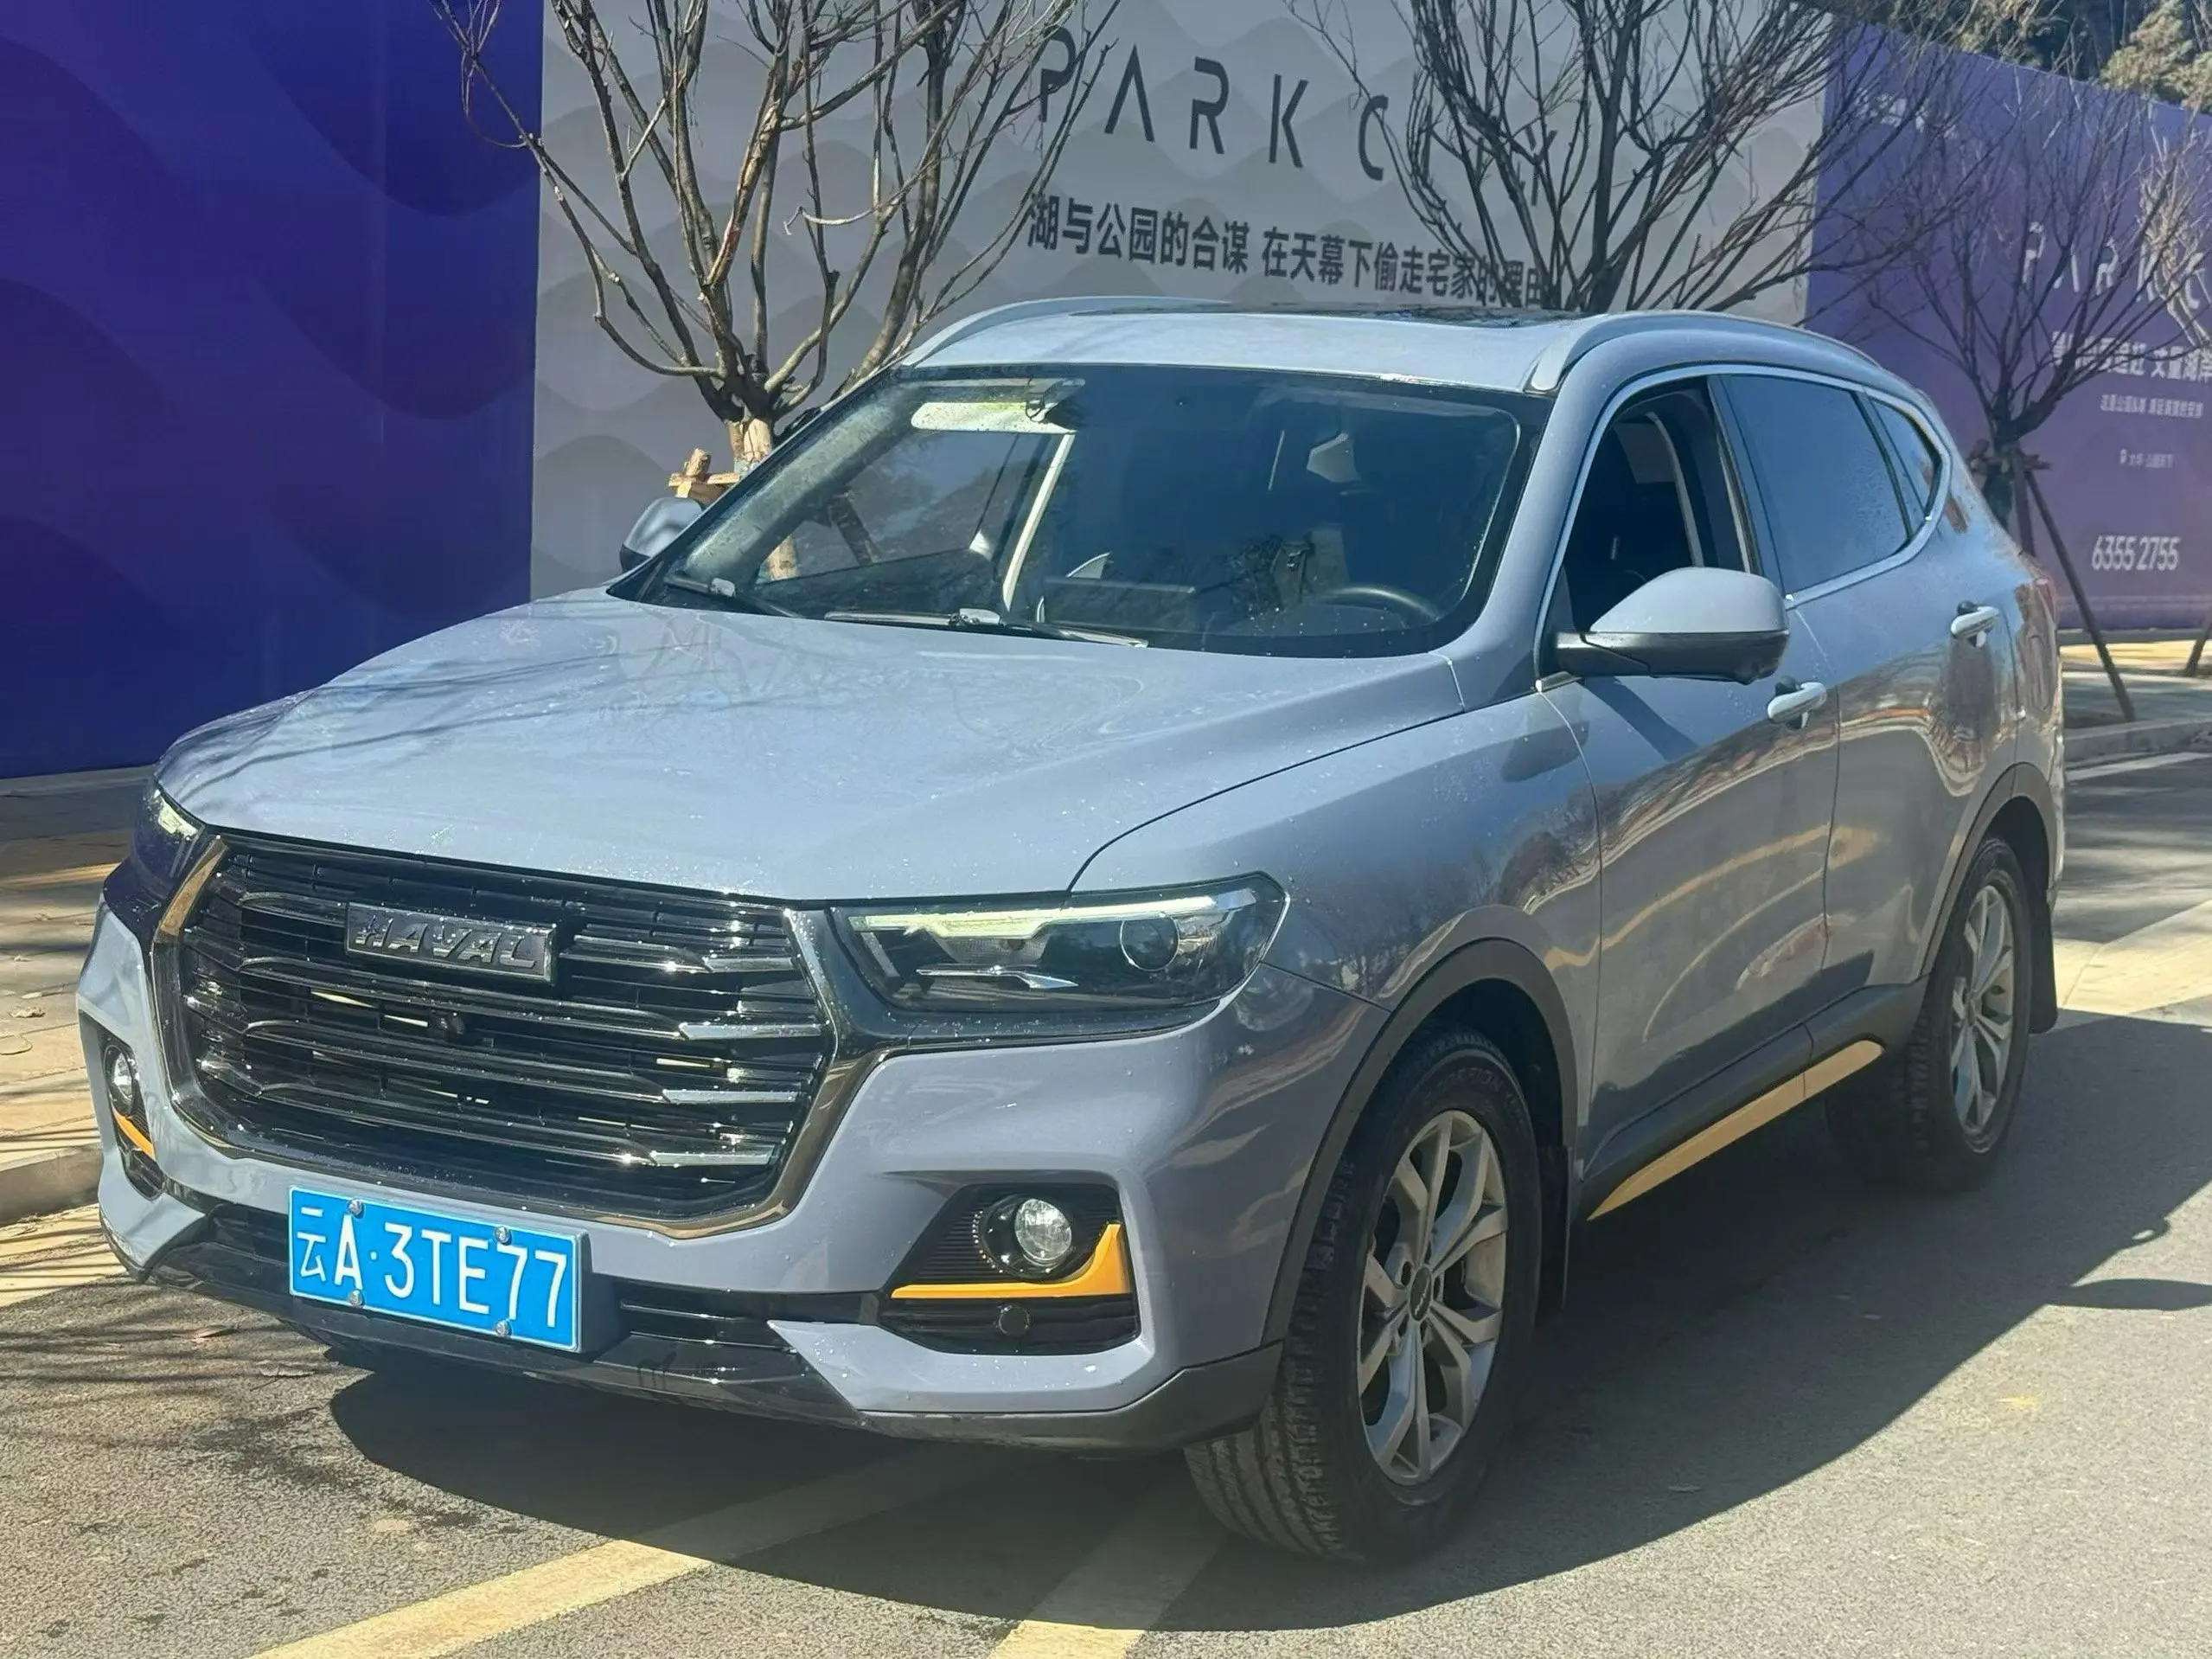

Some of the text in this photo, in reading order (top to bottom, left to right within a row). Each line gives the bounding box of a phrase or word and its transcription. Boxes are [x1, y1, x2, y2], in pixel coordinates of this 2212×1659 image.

[1039, 24, 1308, 168] PARK
[1027, 194, 1250, 274] 湖与公园的合谋
[2092, 535, 2182, 571] 6355 2755
[355, 915, 536, 968] HAVAL
